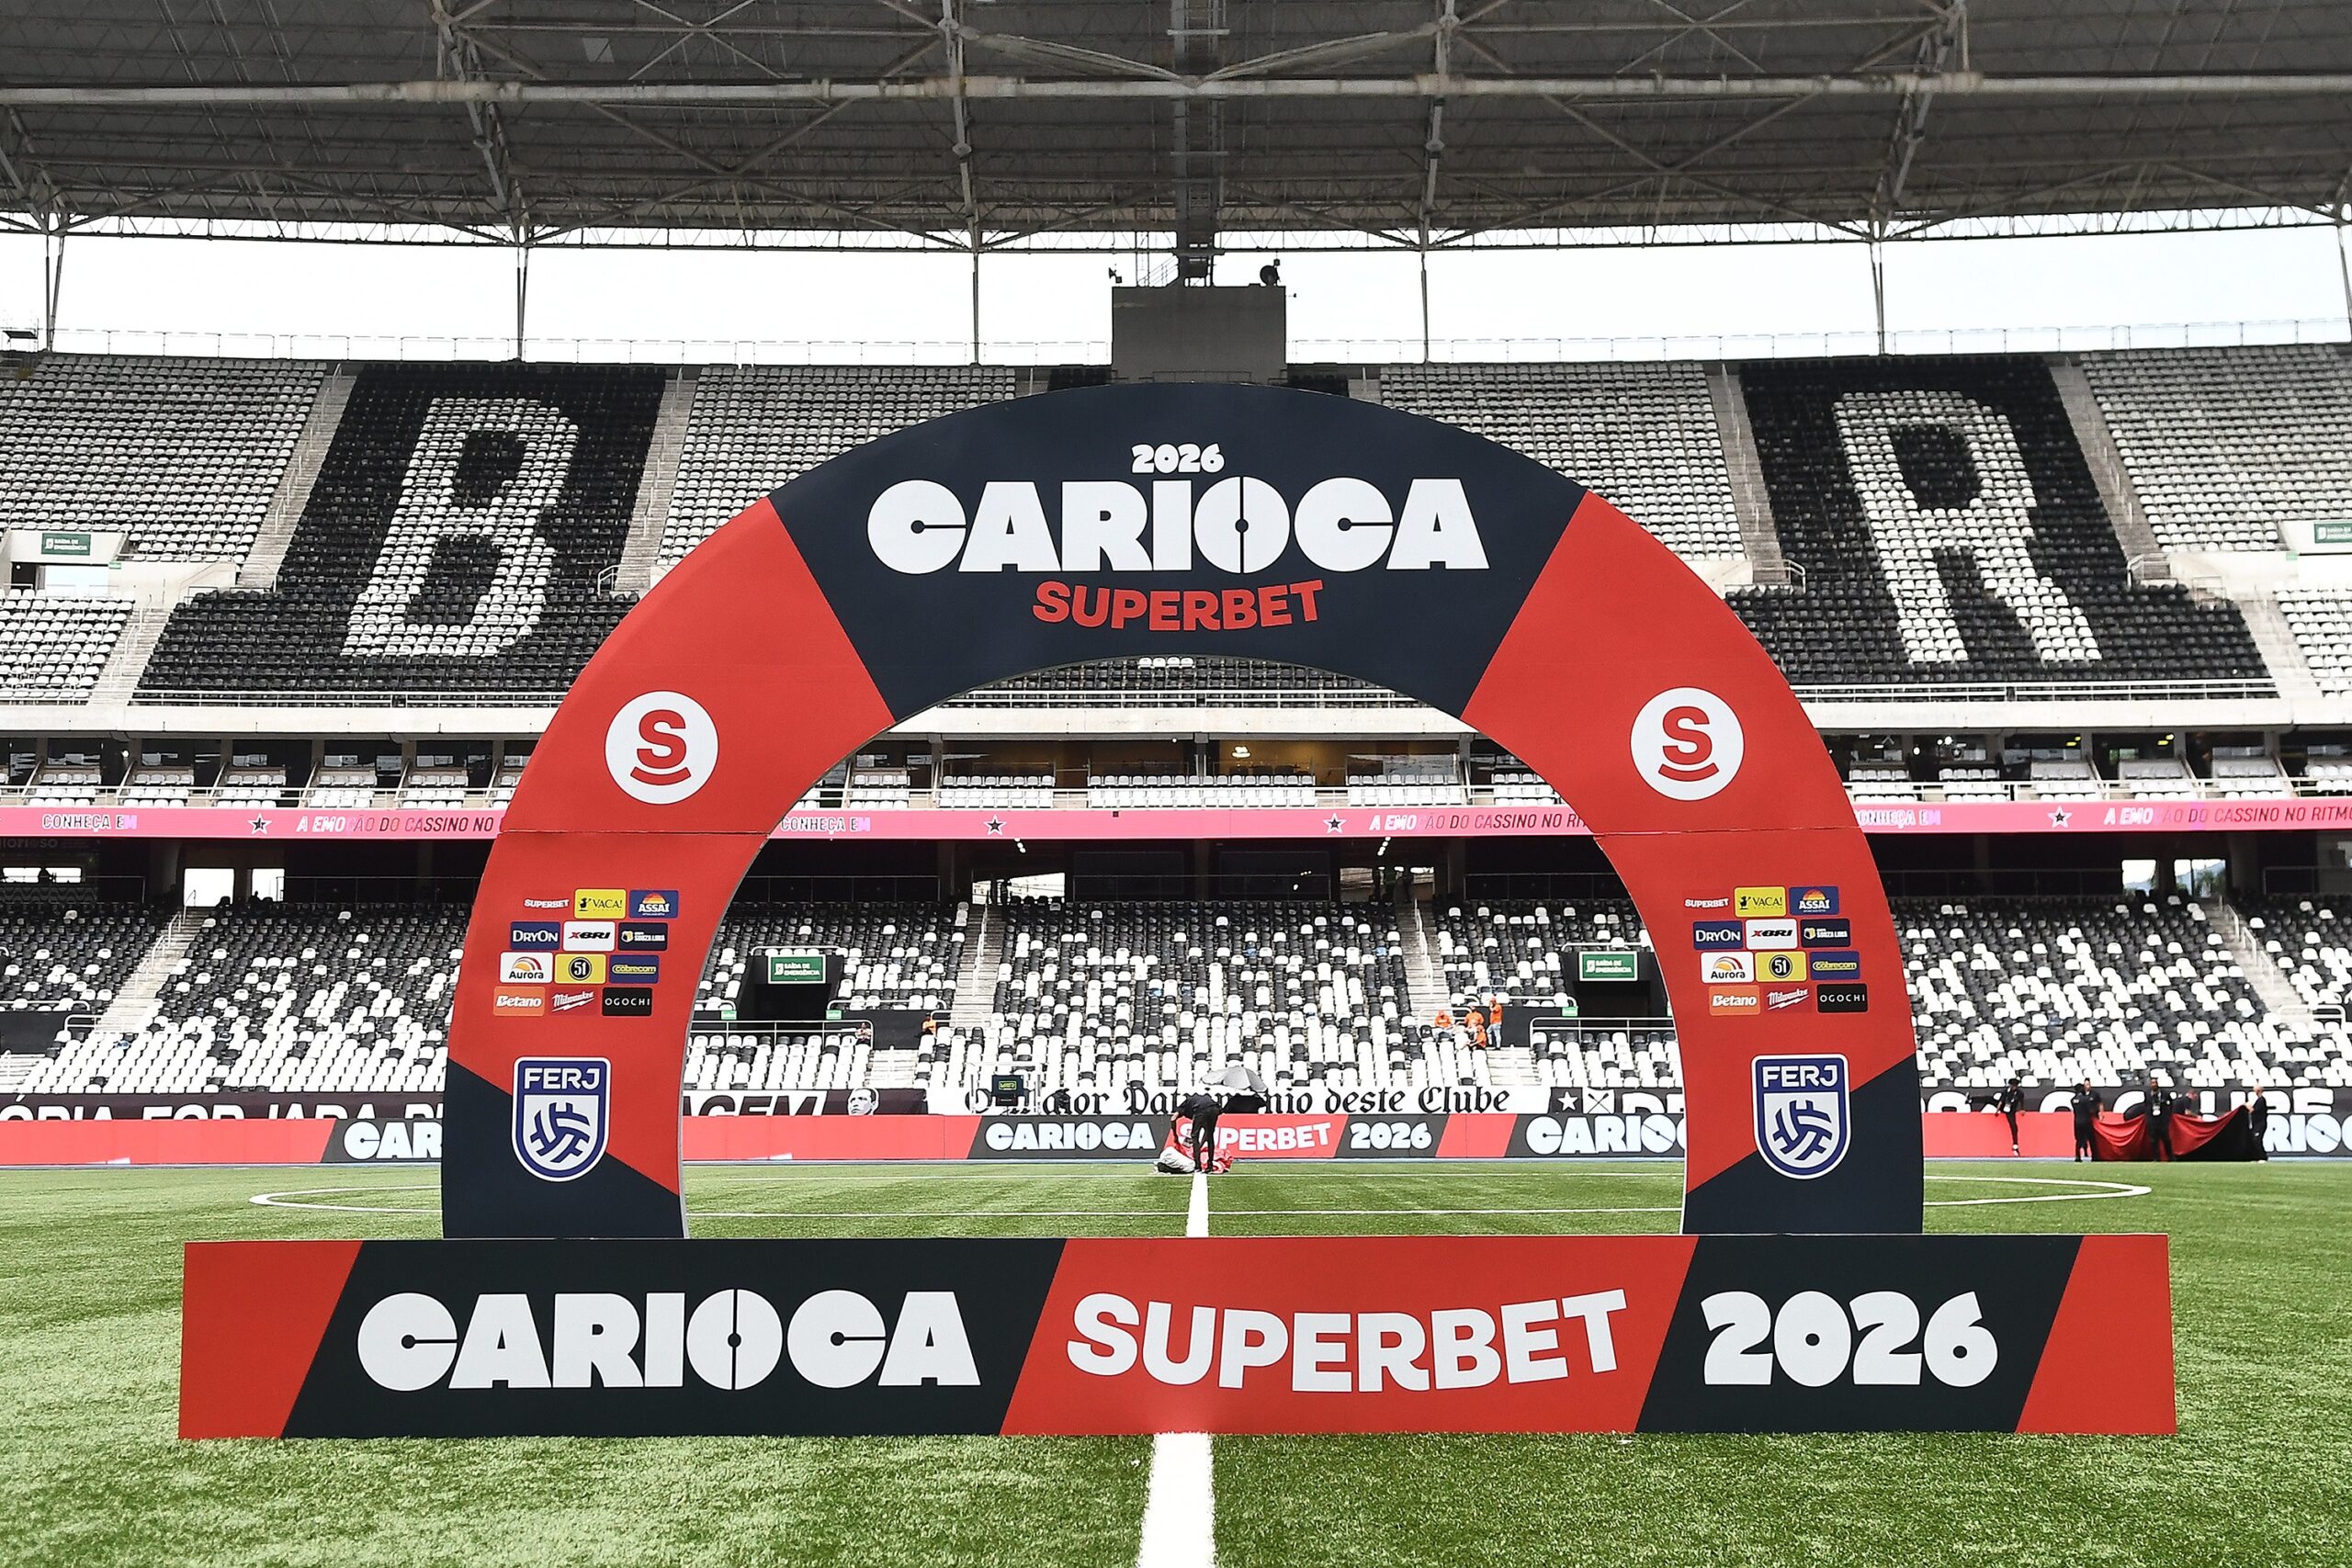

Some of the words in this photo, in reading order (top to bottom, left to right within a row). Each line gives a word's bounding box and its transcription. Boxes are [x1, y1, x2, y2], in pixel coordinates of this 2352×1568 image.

[1131, 444, 1225, 473] 2026
[867, 476, 1490, 575] CARIOCA
[1033, 580, 1325, 631] SUPERBET
[41, 813, 111, 833] CONHEÇA
[296, 815, 309, 832] A
[379, 816, 401, 832] DO
[404, 817, 469, 832] CASSINO
[472, 817, 494, 832] NO
[1369, 815, 1381, 830] A
[1449, 814, 1470, 829] DO
[1474, 813, 1537, 829] CASSINO
[1541, 813, 1563, 829] NO
[2103, 807, 2116, 825] A
[2188, 807, 2209, 823] DO
[2214, 807, 2279, 823] CASSINO
[2284, 807, 2305, 822] NO
[780, 816, 846, 836] CONHEÇA
[524, 897, 571, 908] SUPERBET
[593, 898, 623, 908] VACA!
[1684, 897, 1730, 908] SUPERBET
[1752, 897, 1782, 907] VACA!
[508, 969, 544, 979] Aurora
[573, 962, 587, 976] 51
[1710, 969, 1746, 979] Aurora
[1774, 960, 1787, 974] 51
[496, 995, 542, 1008] Betano
[604, 997, 650, 1007] OGOCHI
[1712, 995, 1758, 1008] Betano
[1819, 994, 1865, 1003] OGOCHI
[524, 1067, 601, 1090] FERJ
[1762, 1065, 1838, 1088] FERJ
[1325, 1088, 1406, 1114] deste
[1418, 1086, 1510, 1114] Clube
[985, 1122, 1157, 1151] CARIOCA
[1350, 1122, 1433, 1150] 2026
[1525, 1113, 1684, 1155] CARIO
[357, 1288, 980, 1393] CARIOCA
[1066, 1288, 1628, 1393] SUPERBET
[1701, 1291, 1998, 1388] 2026
